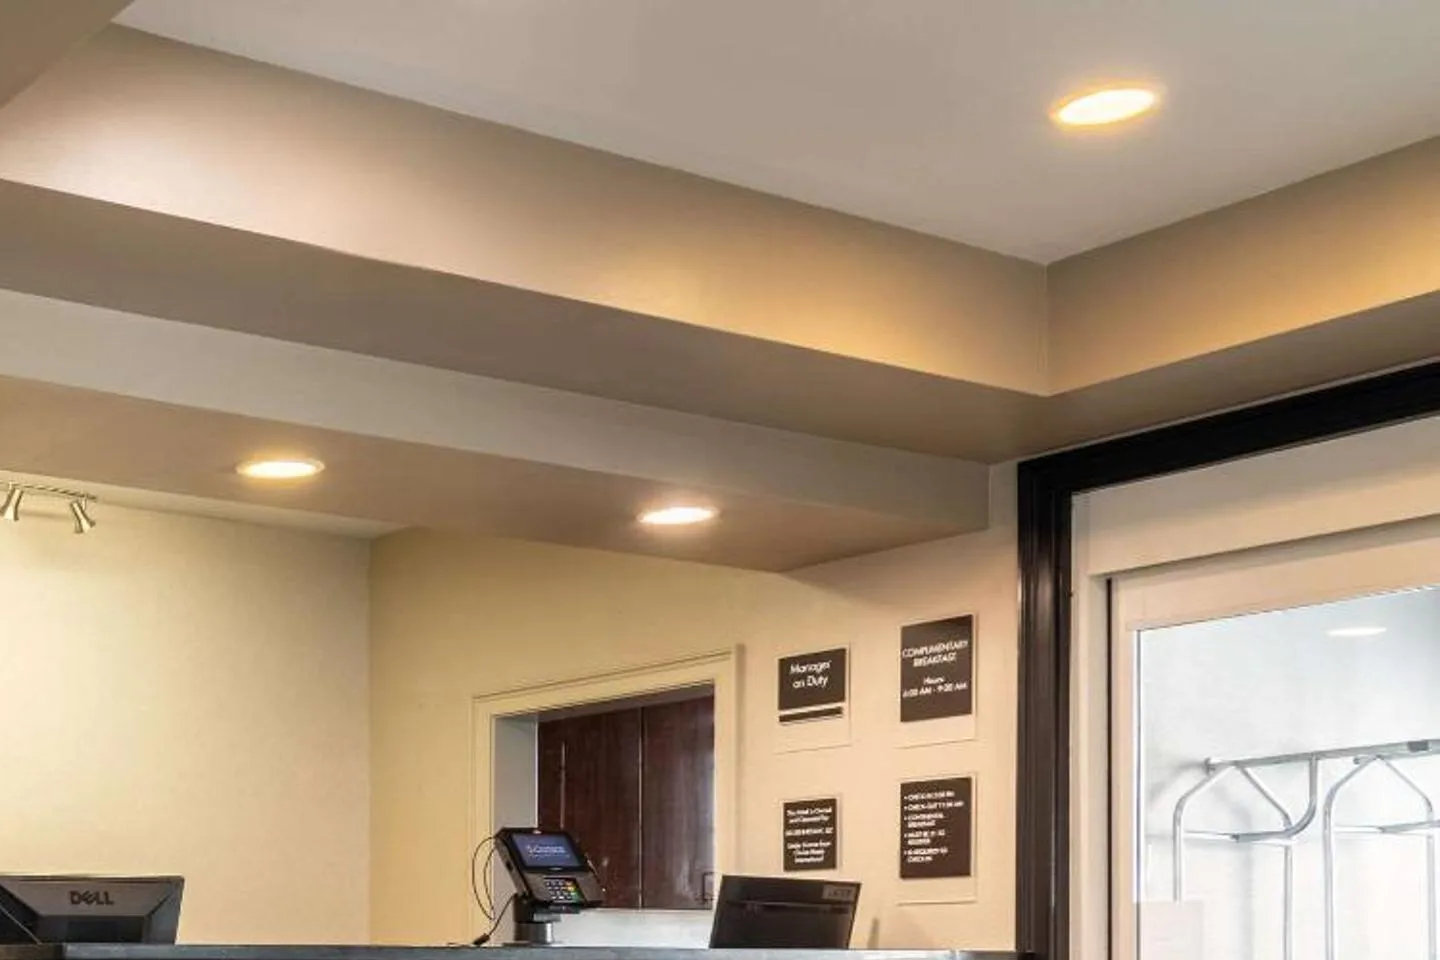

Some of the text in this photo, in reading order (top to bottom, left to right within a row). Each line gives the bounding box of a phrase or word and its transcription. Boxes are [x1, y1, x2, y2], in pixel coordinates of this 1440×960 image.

[789, 660, 832, 674] Manager
[806, 675, 829, 688] Duty
[70, 890, 114, 905] DELL
